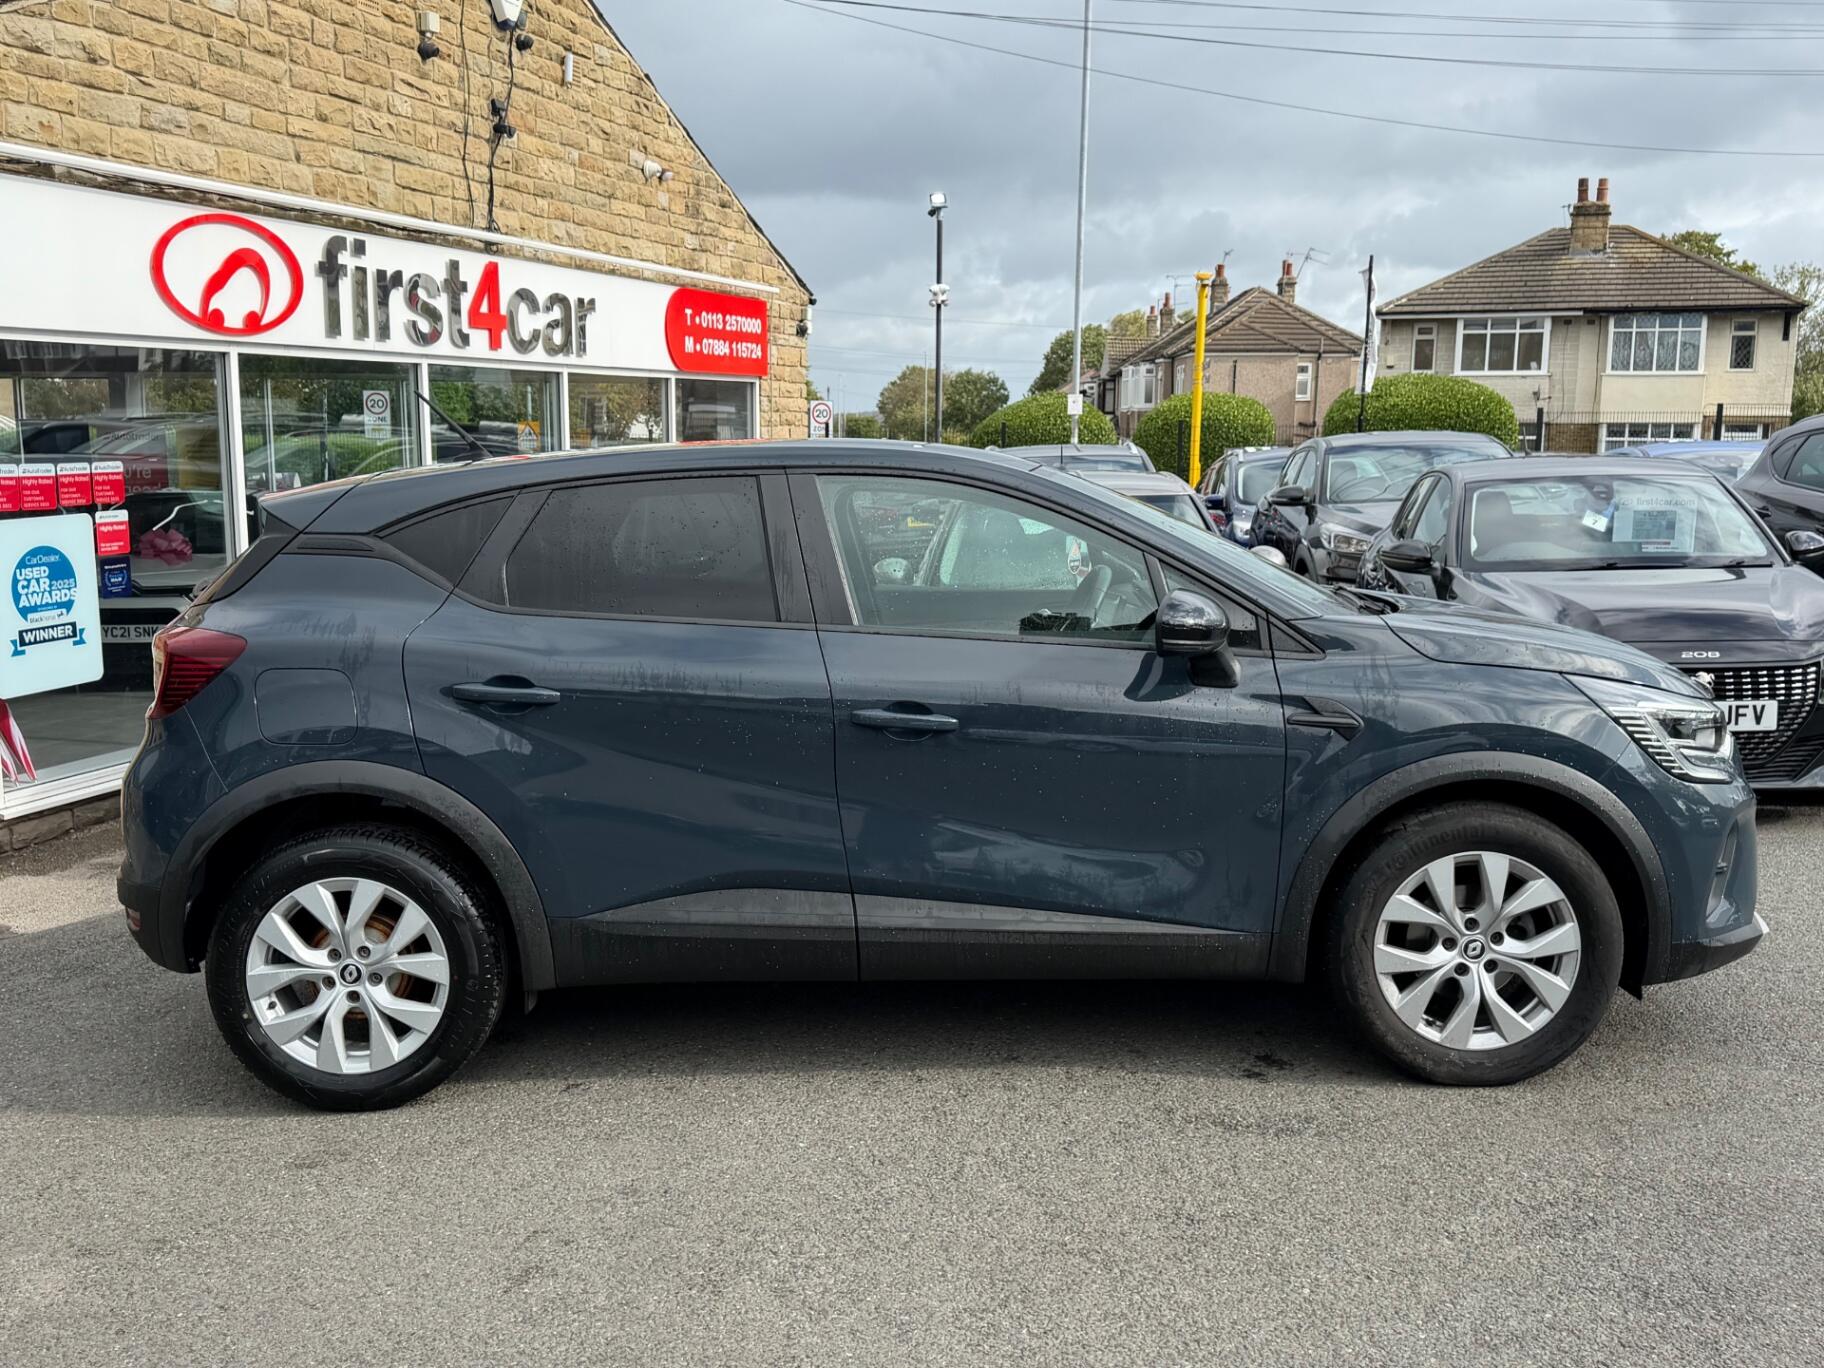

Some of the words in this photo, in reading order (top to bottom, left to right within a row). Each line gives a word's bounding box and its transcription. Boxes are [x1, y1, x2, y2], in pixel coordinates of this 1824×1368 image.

[315, 235, 596, 358] first4car
[684, 308, 693, 326] T
[725, 314, 762, 335] 2570000
[684, 336, 694, 353] M
[702, 338, 730, 356] 07884
[732, 341, 762, 359] 115724
[369, 398, 385, 409] 20
[815, 408, 829, 419] 20
[16, 566, 49, 580] USED
[17, 577, 50, 595] CAR
[51, 578, 75, 590] 2025
[18, 587, 78, 608] AWARDS
[23, 625, 73, 644] WINNER
[102, 626, 131, 638] YC21
